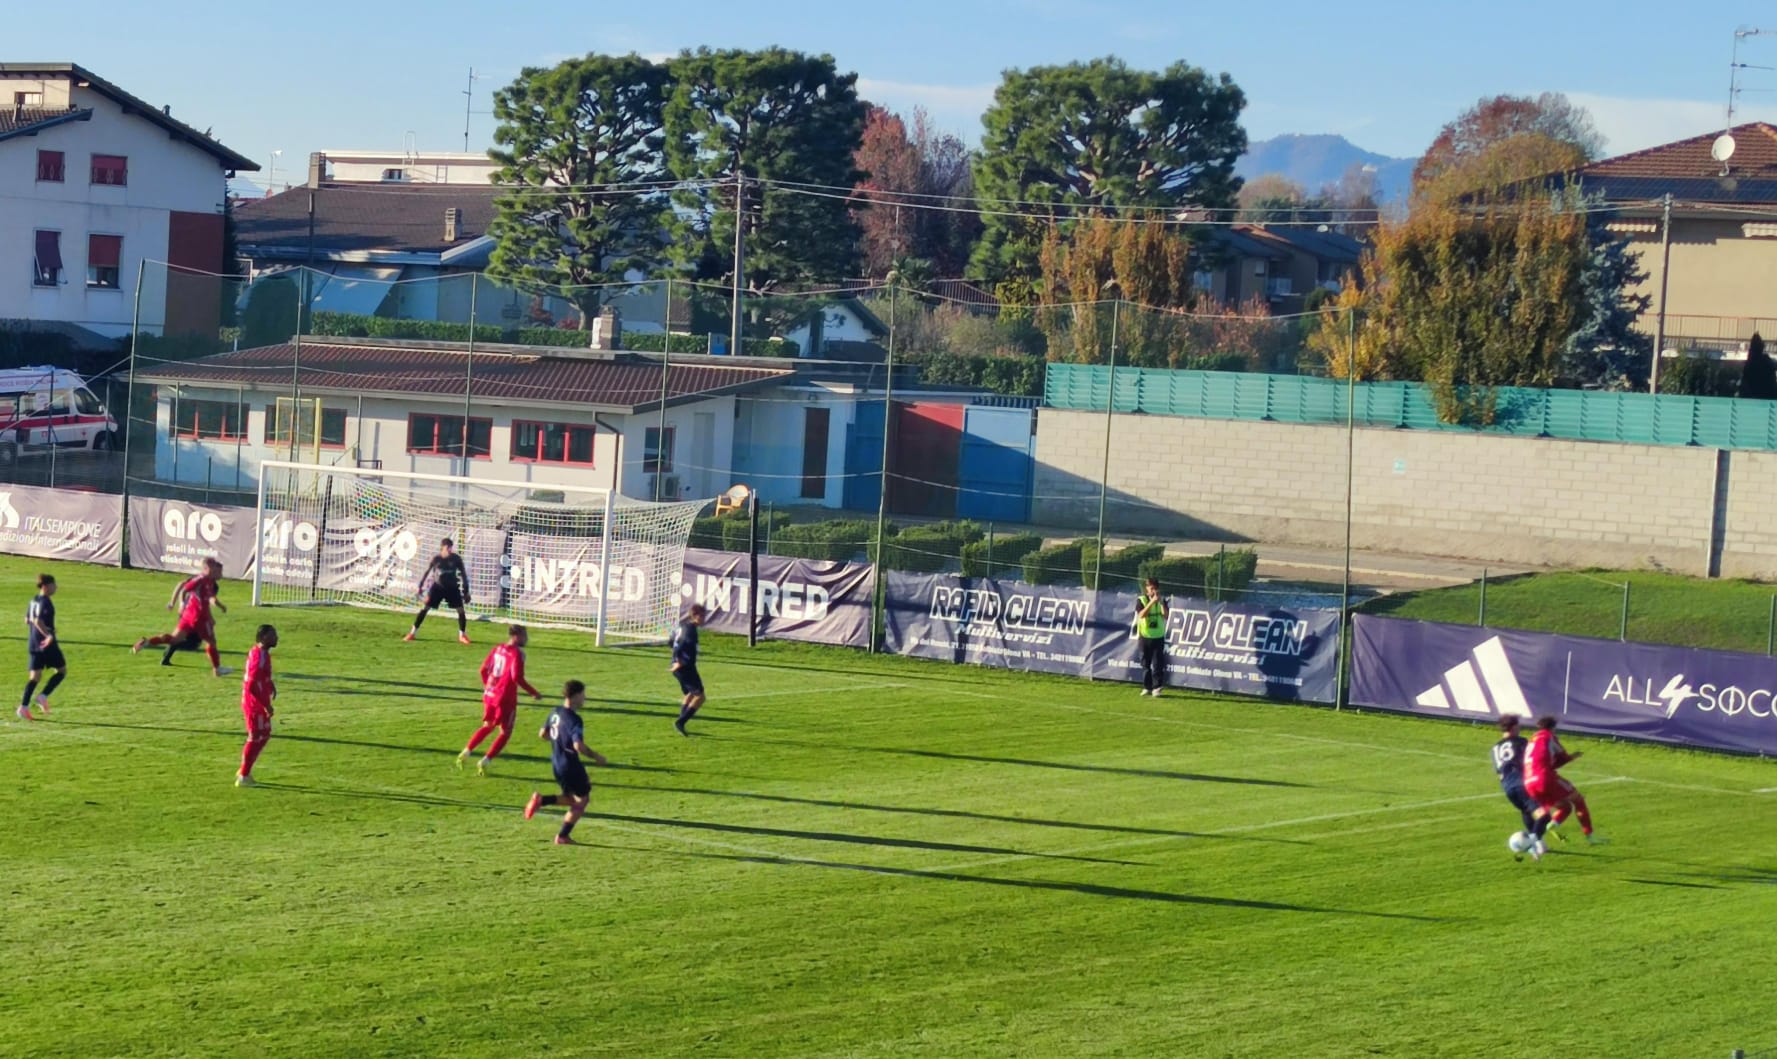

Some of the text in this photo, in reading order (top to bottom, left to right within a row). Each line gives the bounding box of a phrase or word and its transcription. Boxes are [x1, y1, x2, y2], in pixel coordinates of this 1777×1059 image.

[24, 515, 102, 538] ITALSEMPIONE
[164, 509, 222, 541] aro
[524, 556, 645, 601] INTRED
[696, 574, 829, 621] INTRED
[929, 586, 1090, 635] RAPID CLEAN
[1130, 608, 1307, 656] PID CLEAN
[1163, 644, 1266, 666] Multiservizi
[550, 713, 561, 740] 3
[1492, 741, 1515, 769] 16
